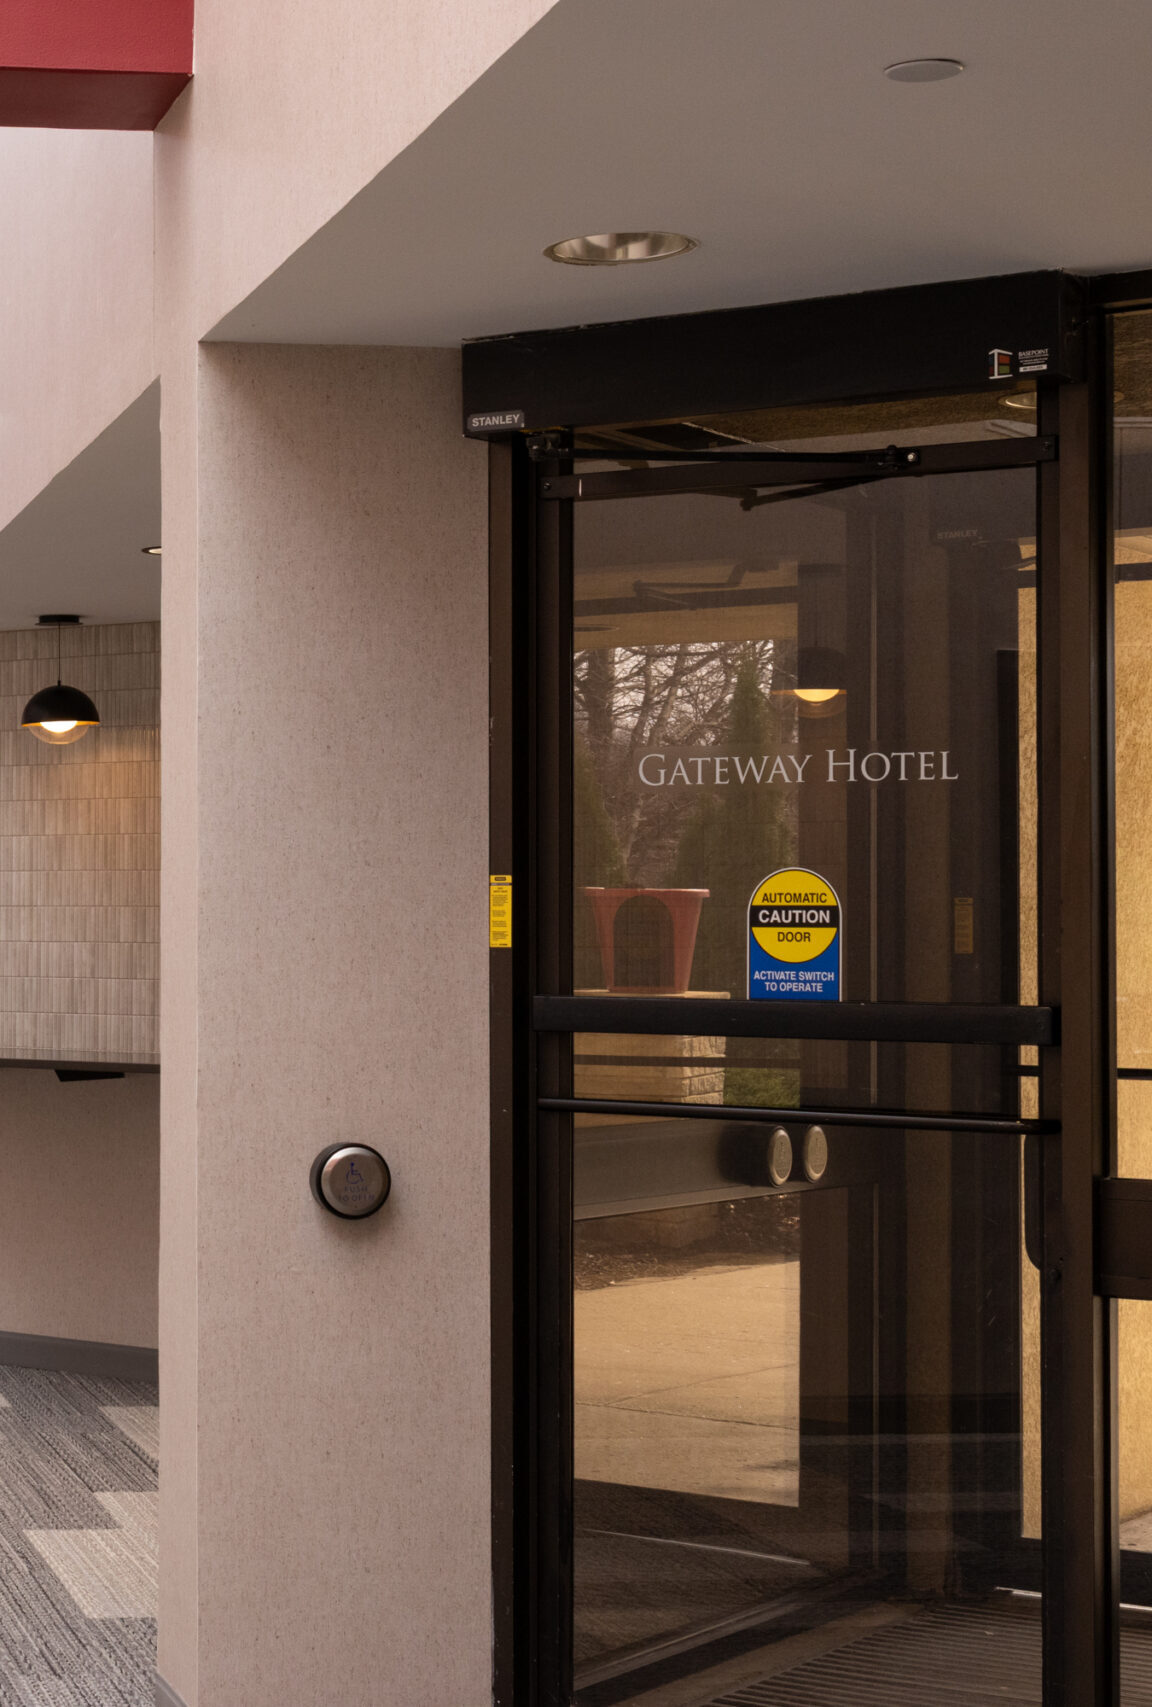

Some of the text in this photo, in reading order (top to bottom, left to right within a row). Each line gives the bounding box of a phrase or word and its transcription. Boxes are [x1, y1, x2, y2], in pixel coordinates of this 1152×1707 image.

[1018, 348, 1049, 357] BASEPOINT
[472, 414, 520, 427] STANLEY
[638, 748, 960, 787] GATEWAY HOTEL
[761, 892, 828, 904] AUTOMATIC
[758, 909, 830, 924] CAUTION
[777, 931, 812, 943] DOOR
[753, 970, 835, 982] ACTIVATE SWITCH
[764, 982, 824, 993] TO OPERATE
